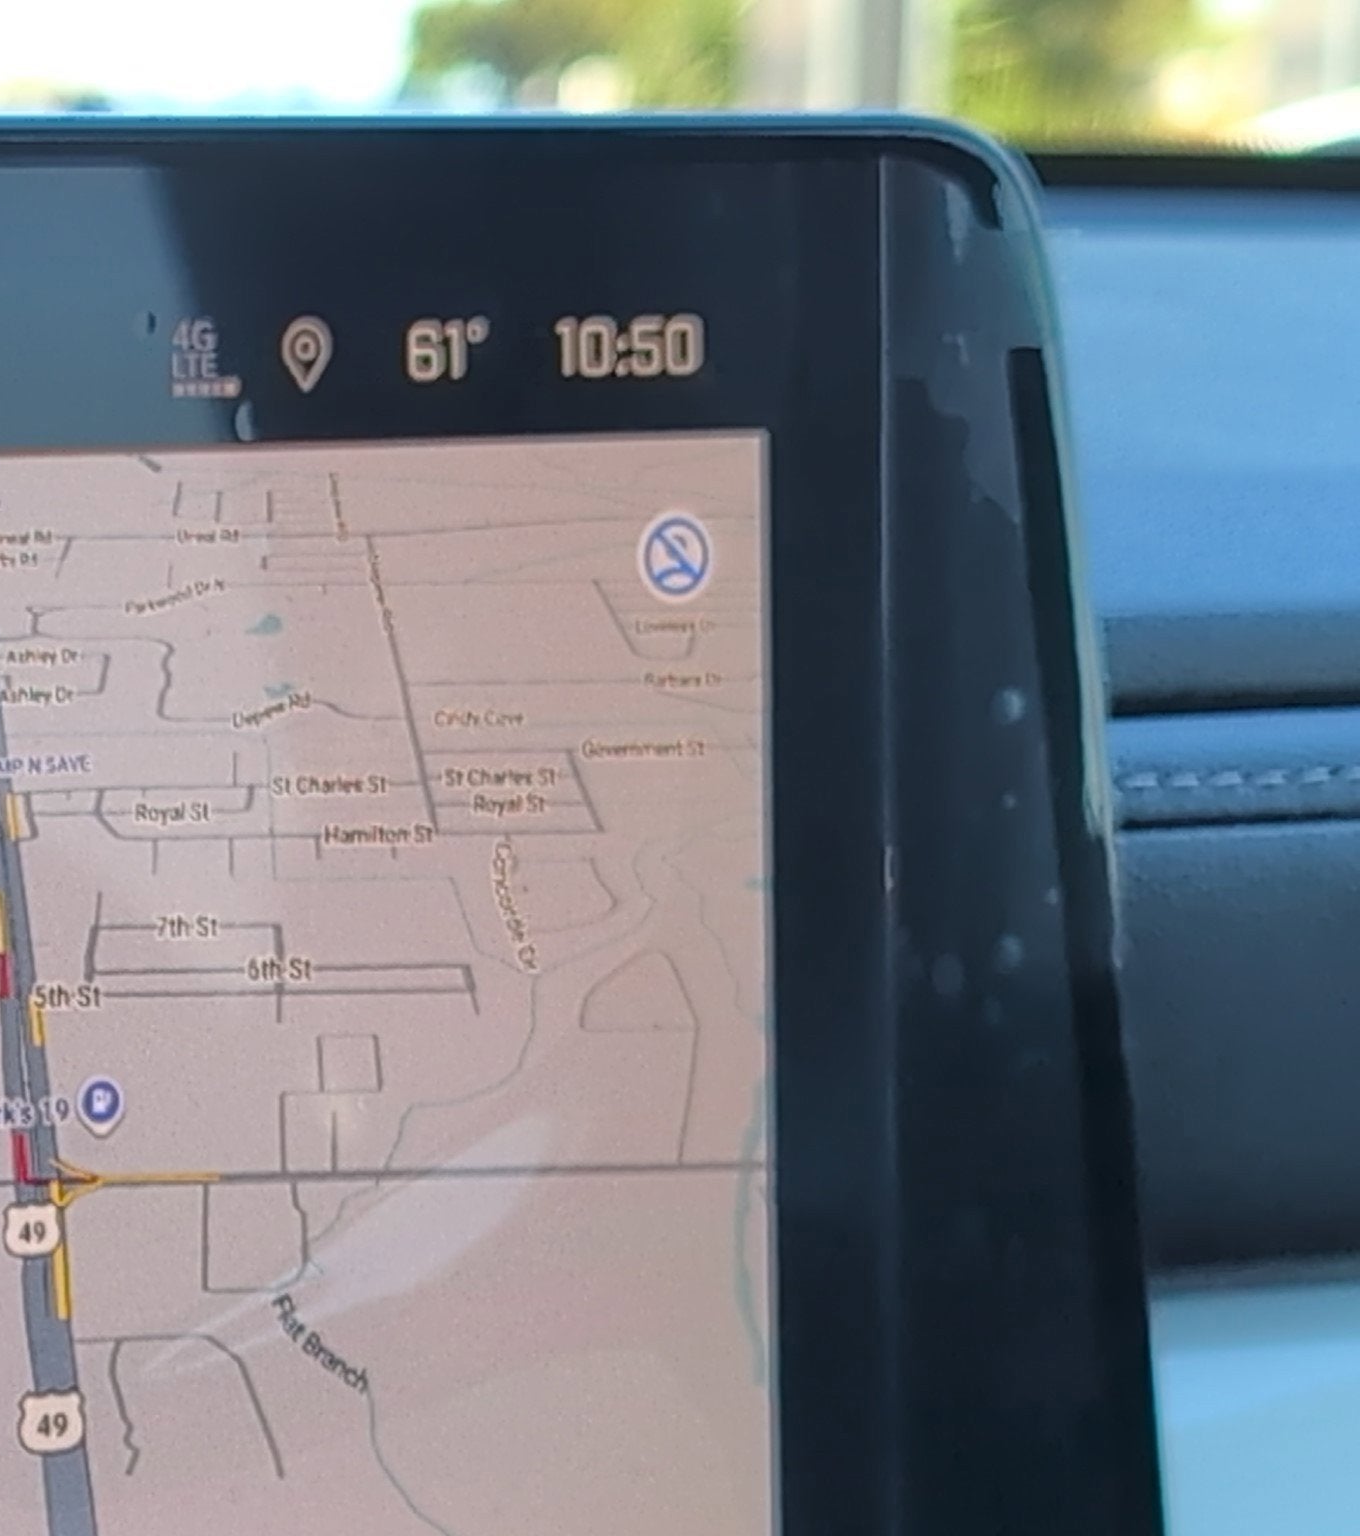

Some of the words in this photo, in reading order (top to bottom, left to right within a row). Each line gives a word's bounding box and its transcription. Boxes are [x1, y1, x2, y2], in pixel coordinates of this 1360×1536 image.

[172, 316, 217, 352] 4G
[555, 314, 705, 378] 10:50
[172, 353, 219, 378] LTE
[272, 778, 292, 796] St
[295, 776, 365, 795] Charles
[367, 775, 387, 793] St
[444, 769, 463, 787] St
[467, 767, 534, 787] Charles
[539, 767, 557, 786] St
[134, 803, 184, 826] Royal
[187, 803, 210, 821] St
[473, 794, 524, 819] Royal
[324, 827, 410, 845] Hamilton
[413, 825, 434, 844] St
[156, 917, 191, 937] 7th
[194, 917, 219, 937] St
[247, 957, 281, 980] 6th
[288, 957, 312, 980] St
[34, 986, 71, 1009] 5th
[76, 986, 102, 1009] St
[18, 1220, 47, 1244] 49
[300, 1333, 371, 1394] Branch
[36, 1412, 69, 1437] 49
